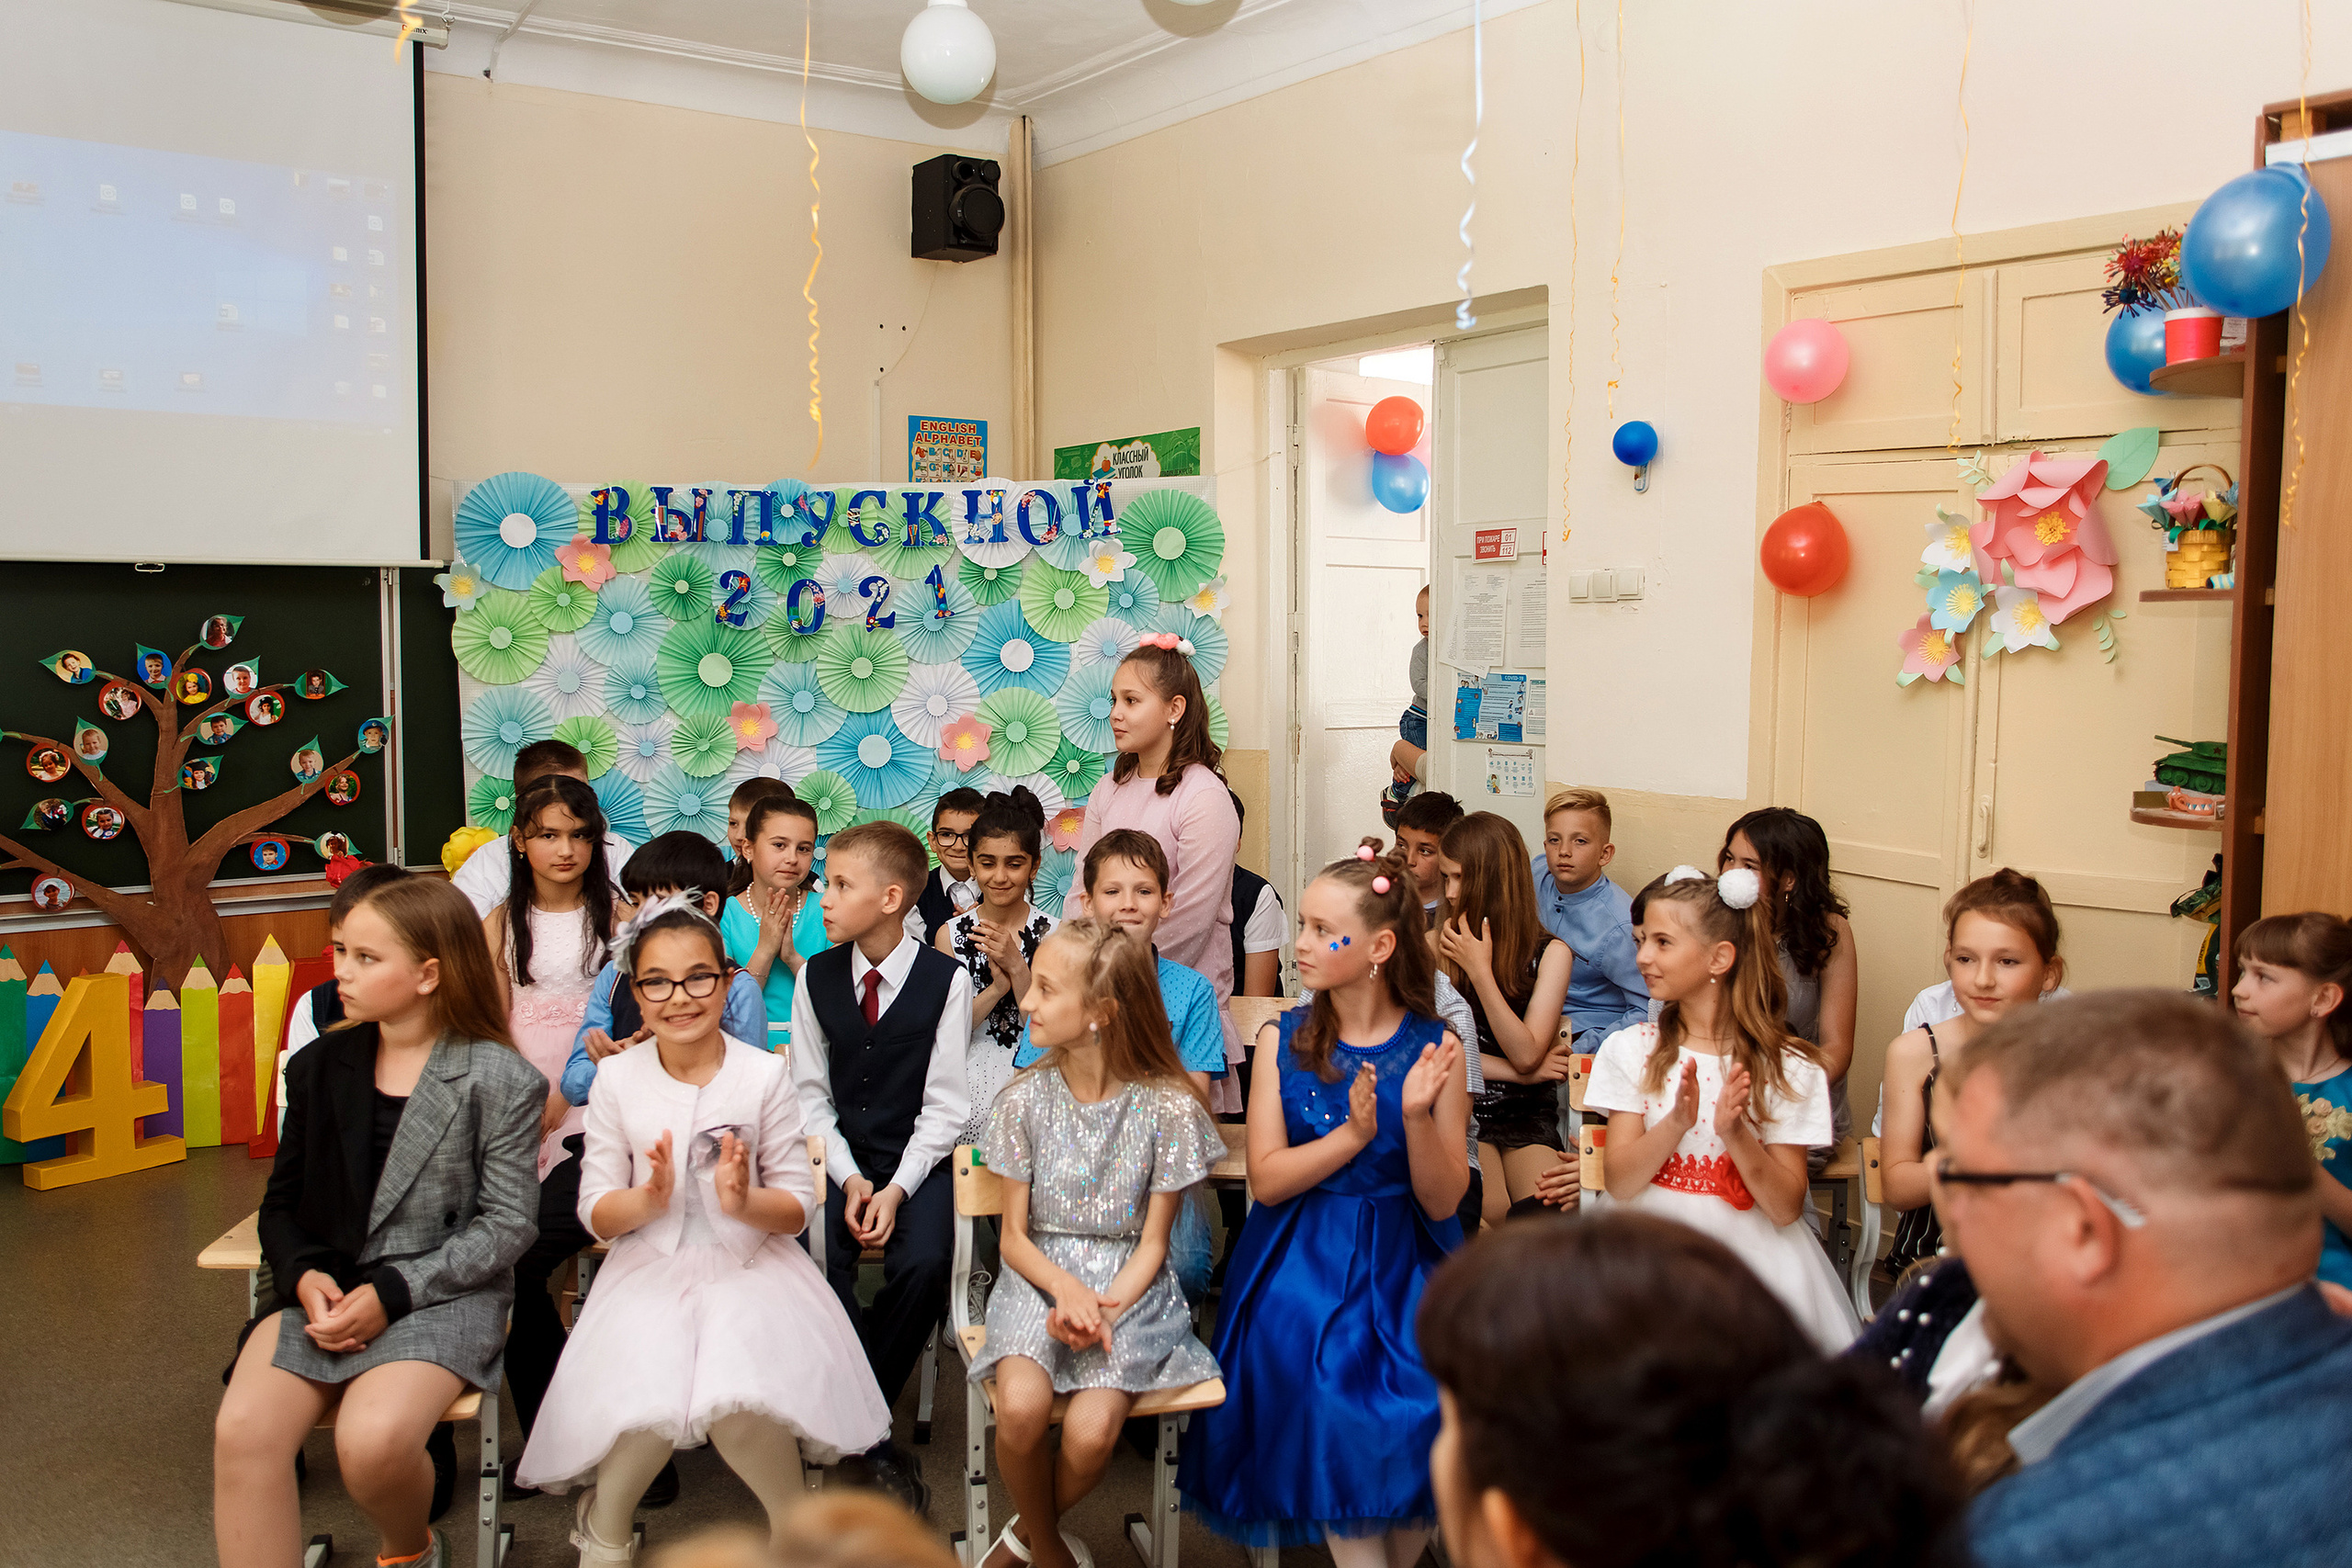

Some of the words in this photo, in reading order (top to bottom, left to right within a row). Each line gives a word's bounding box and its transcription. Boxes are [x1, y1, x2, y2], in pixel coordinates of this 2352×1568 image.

[921, 421, 977, 434] ENGLISH
[915, 433, 982, 446] ALPHABET
[929, 447, 936, 456] B
[943, 447, 950, 457] C
[956, 448, 964, 457] D
[970, 450, 977, 458] E
[1113, 446, 1148, 466] КЛАССНЫЙ
[929, 463, 936, 471] G
[970, 465, 977, 473] J
[1118, 465, 1143, 479] УГОЛОК
[590, 478, 1122, 548] ВЫПУСКНОЙ
[1476, 536, 1485, 544] ПРИ
[1485, 535, 1500, 543] ПОЖАРЕ
[1504, 534, 1512, 542] 01
[1479, 545, 1496, 554] ЗВОНИТЬ
[1501, 547, 1512, 555] 112
[715, 564, 956, 635] 2021
[3, 972, 187, 1191] 4
